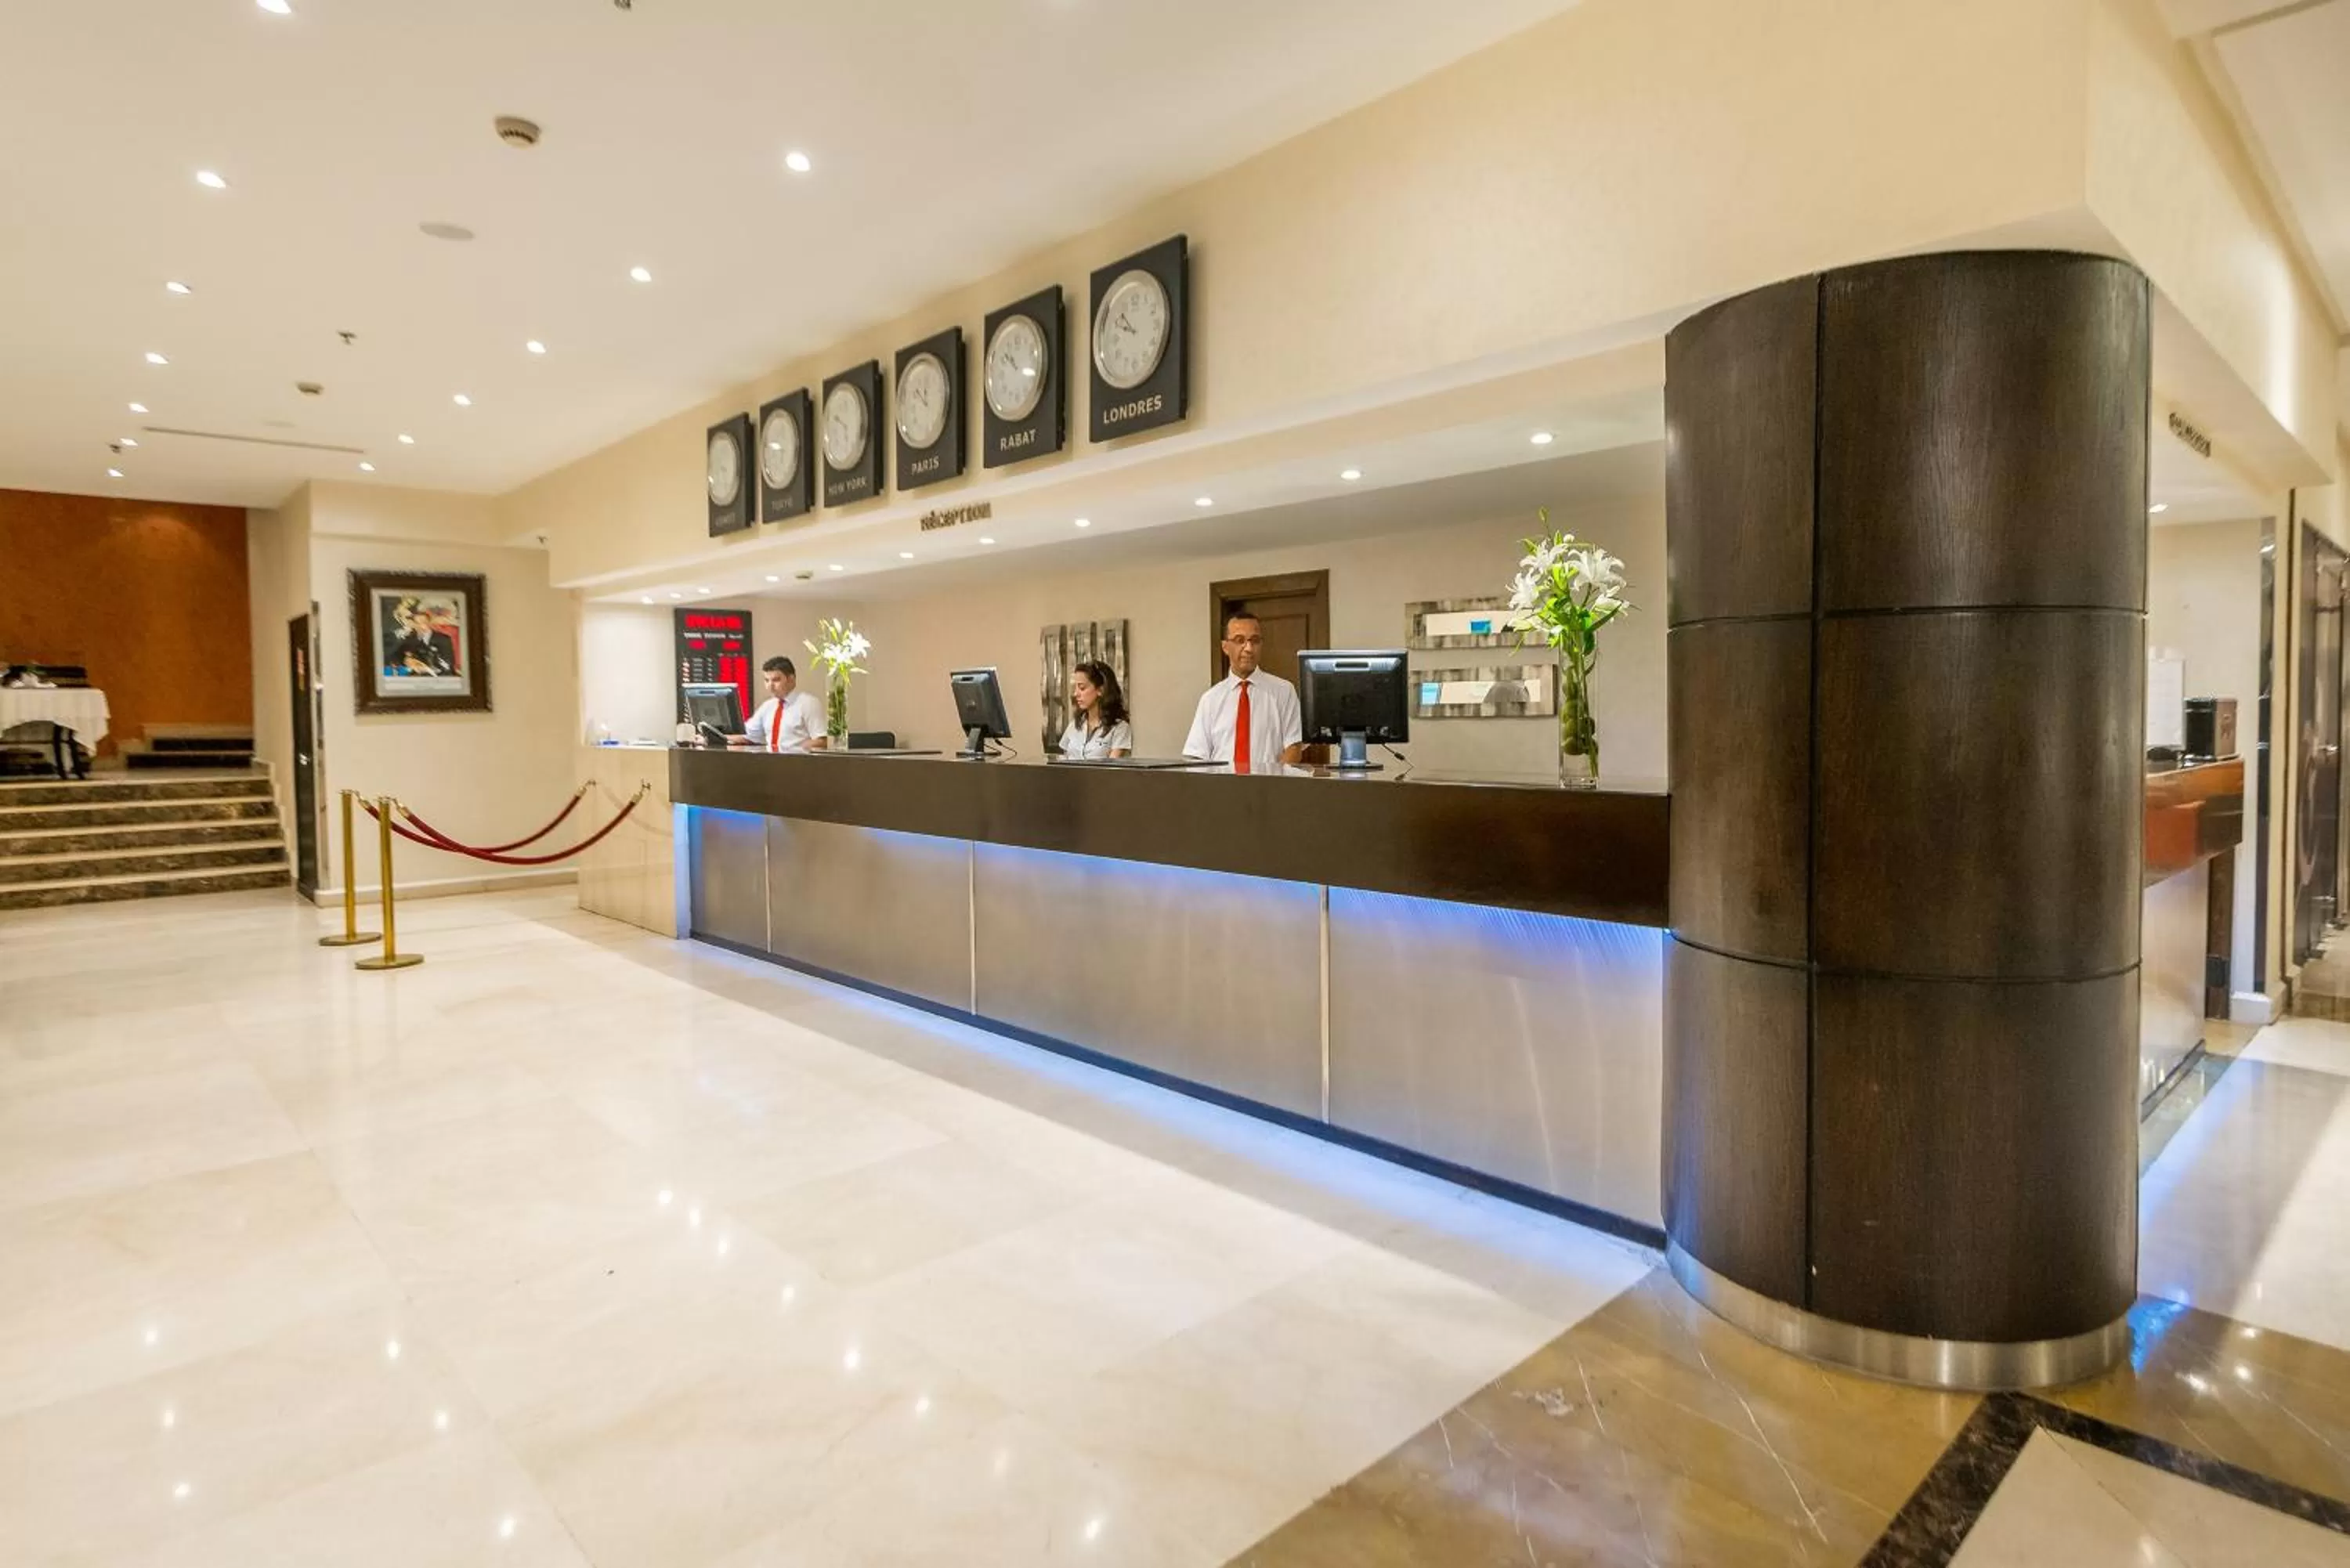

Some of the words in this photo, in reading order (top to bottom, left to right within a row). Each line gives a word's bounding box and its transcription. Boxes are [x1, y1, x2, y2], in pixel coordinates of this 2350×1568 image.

[1103, 394, 1162, 425] LONDRES
[1000, 428, 1036, 452] RABAT
[911, 455, 940, 476] PARIS
[828, 480, 845, 496] NEW
[846, 475, 868, 490] YORK
